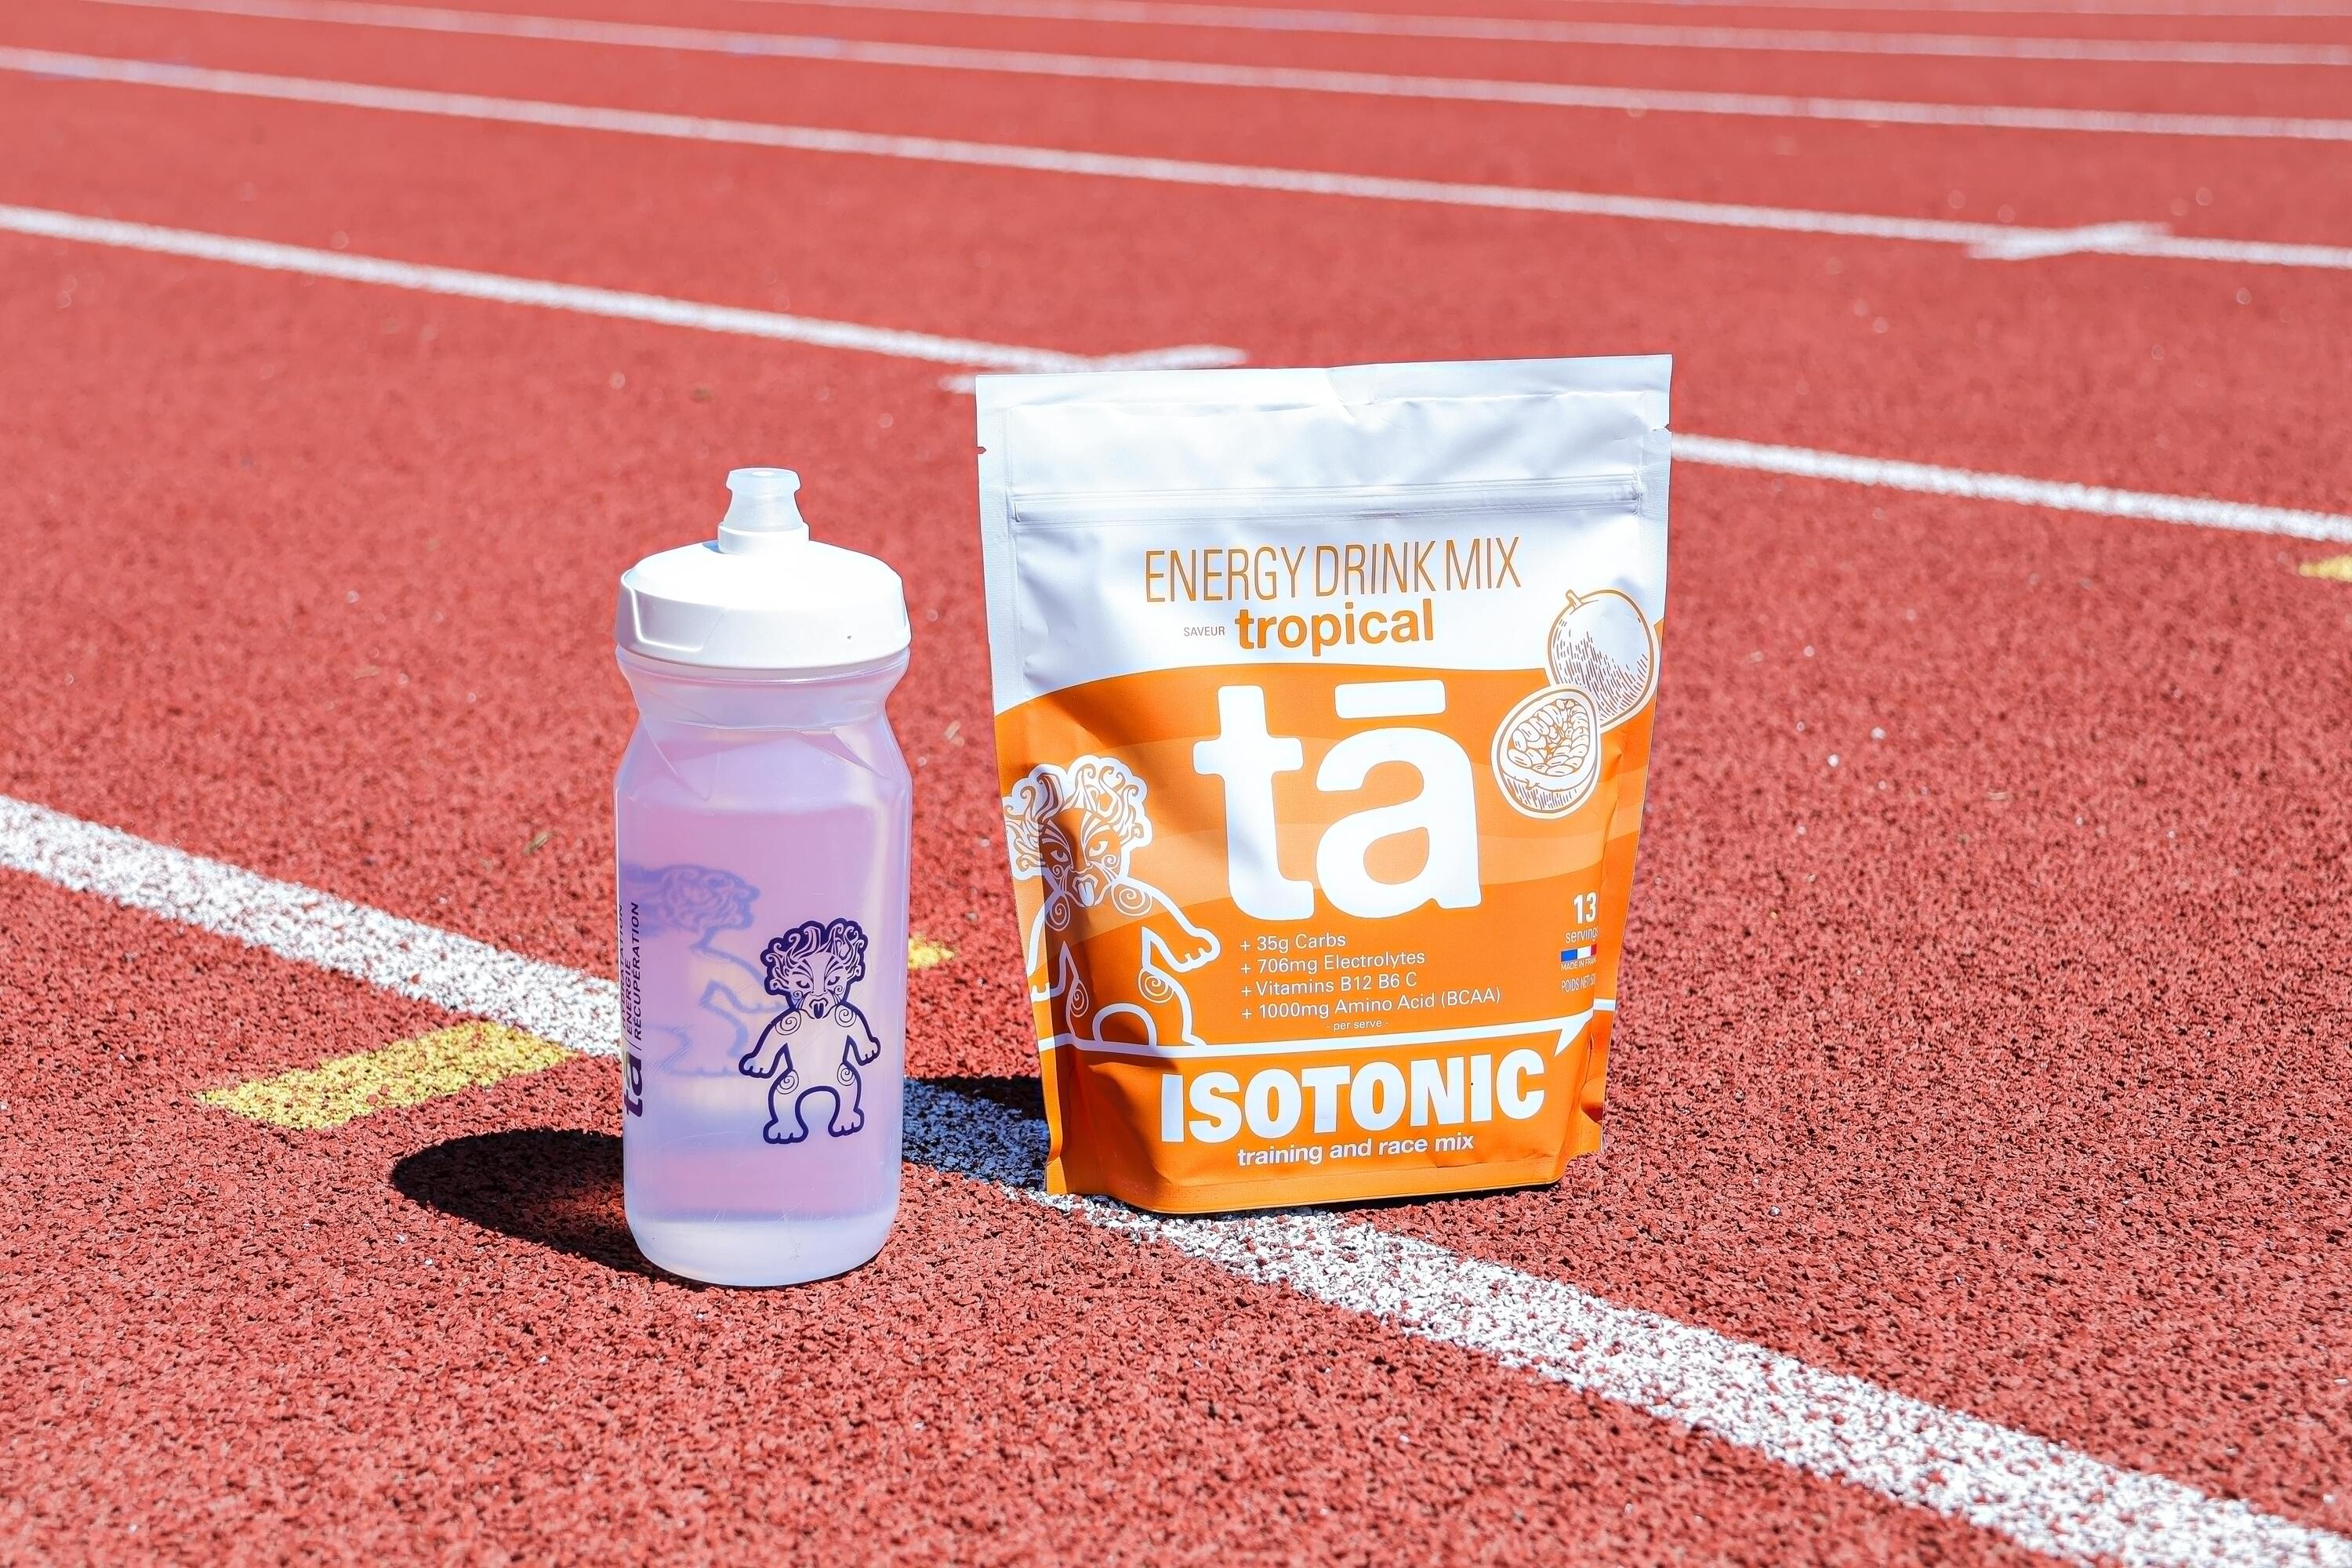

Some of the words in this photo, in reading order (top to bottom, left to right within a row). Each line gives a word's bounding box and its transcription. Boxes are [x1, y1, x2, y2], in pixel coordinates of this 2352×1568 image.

[1145, 546, 1306, 603] ENERGY
[1316, 540, 1436, 597] DRINK
[1446, 536, 1522, 591] MIX
[1183, 626, 1225, 637] SAVEUR
[1234, 598, 1434, 657] tropical
[1573, 891, 1597, 924] 13
[1257, 935, 1290, 954] 35g
[1295, 932, 1347, 949] Carbs
[630, 902, 642, 1042] RÉCUPÉRATION
[1257, 957, 1318, 975] 706mg
[1324, 951, 1425, 970] Electrolytes
[1561, 960, 1577, 971] MADE
[1578, 959, 1584, 969] IN
[1255, 978, 1334, 996] Vitamins
[1341, 975, 1372, 992] B12
[1378, 973, 1400, 989] B6
[1406, 971, 1417, 987] C
[1561, 977, 1580, 993] POIDS
[1259, 1002, 1329, 1019] 1000mg
[1334, 997, 1392, 1014] Amino
[1397, 992, 1435, 1011] Acid
[1441, 986, 1501, 1009] (BCAA)
[1334, 1022, 1352, 1033] per
[1353, 1019, 1382, 1029] serve
[1160, 1047, 1545, 1144] ISOTONIC
[1237, 1144, 1323, 1167] training
[1330, 1138, 1372, 1158] and
[1378, 1139, 1428, 1156] race
[1435, 1131, 1475, 1151] mix
